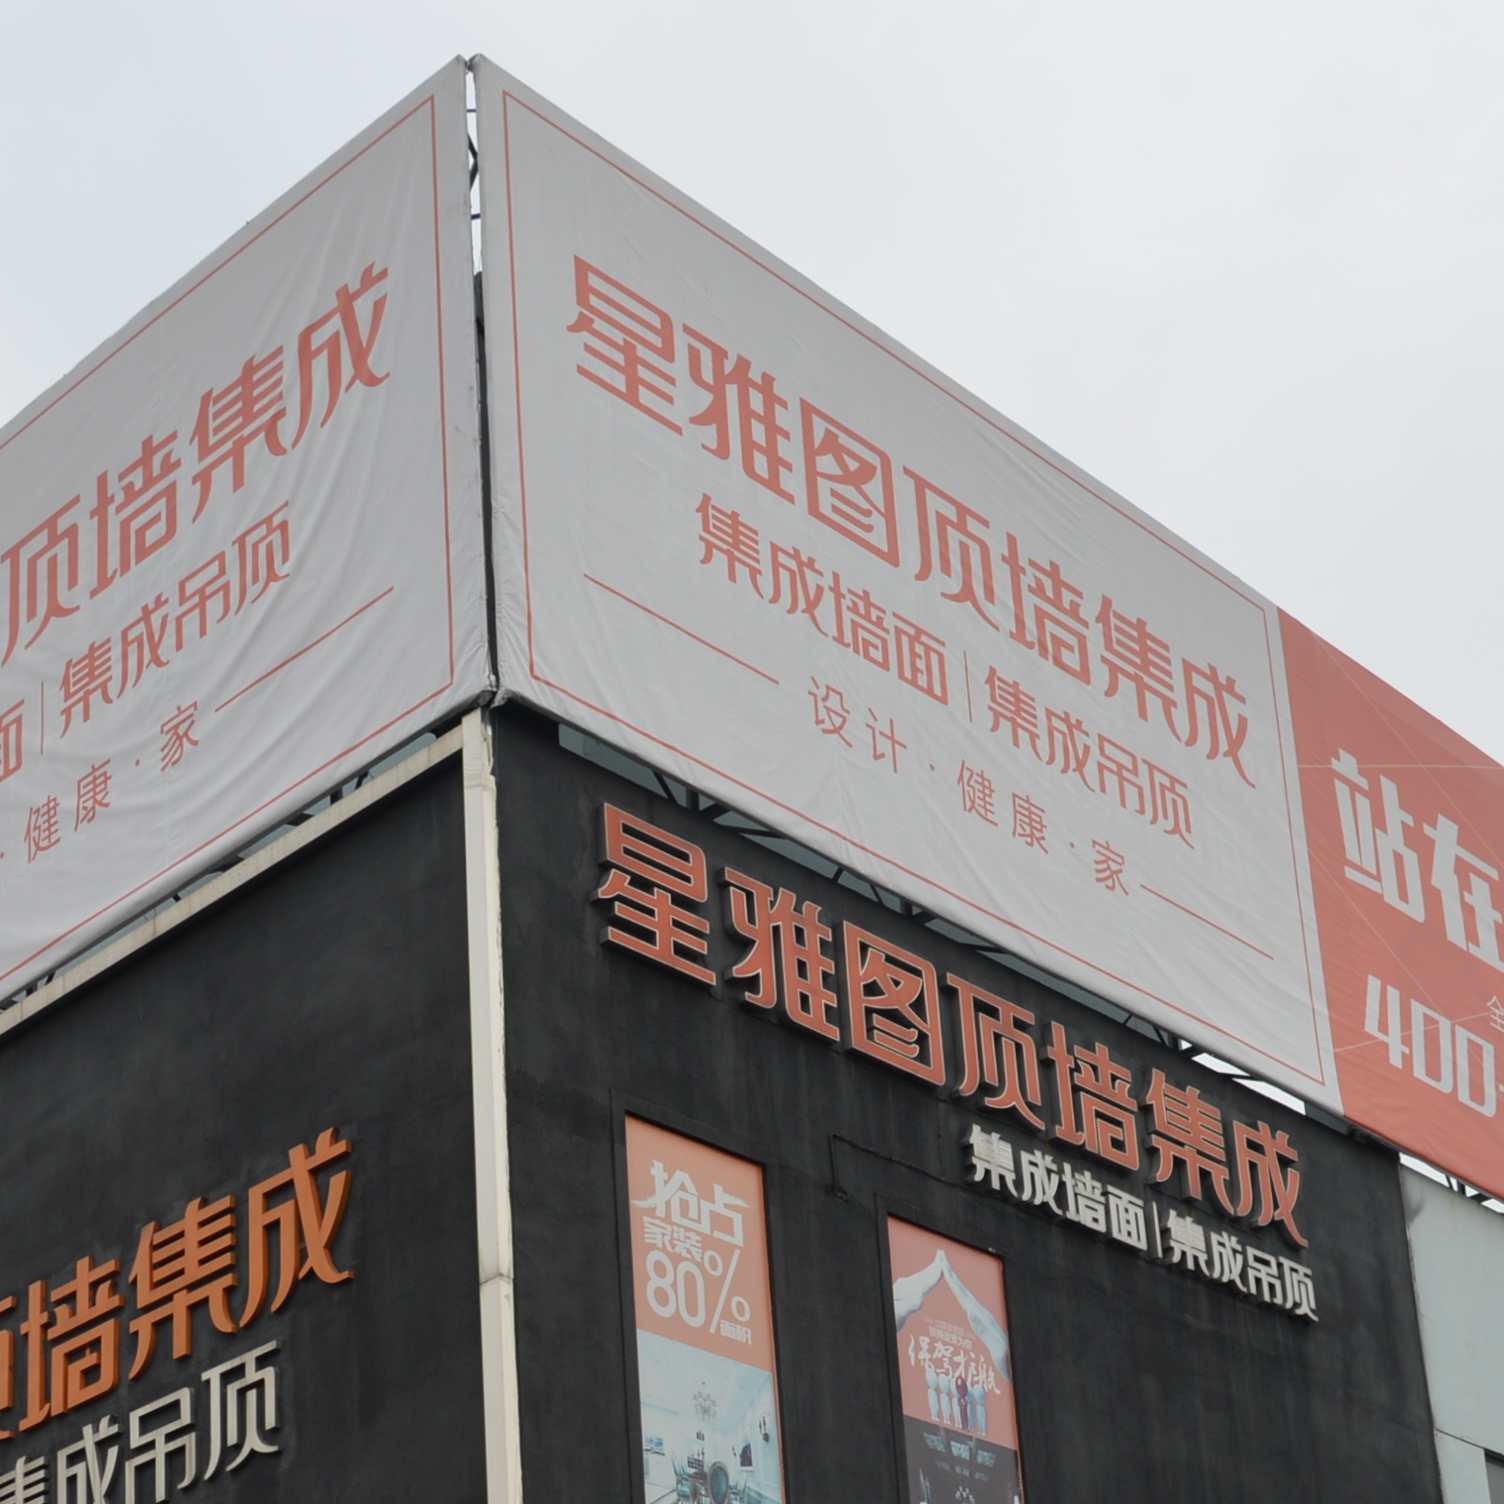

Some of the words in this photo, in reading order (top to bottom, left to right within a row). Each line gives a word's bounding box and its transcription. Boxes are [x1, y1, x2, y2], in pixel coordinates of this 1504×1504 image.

[566, 253, 1256, 789] 星雅图顶墙集成
[593, 802, 1309, 1248] 星雅图顶墙集成
[633, 1159, 750, 1247] 抢占
[643, 1216, 702, 1262] 家装
[646, 1249, 751, 1333] 80%
